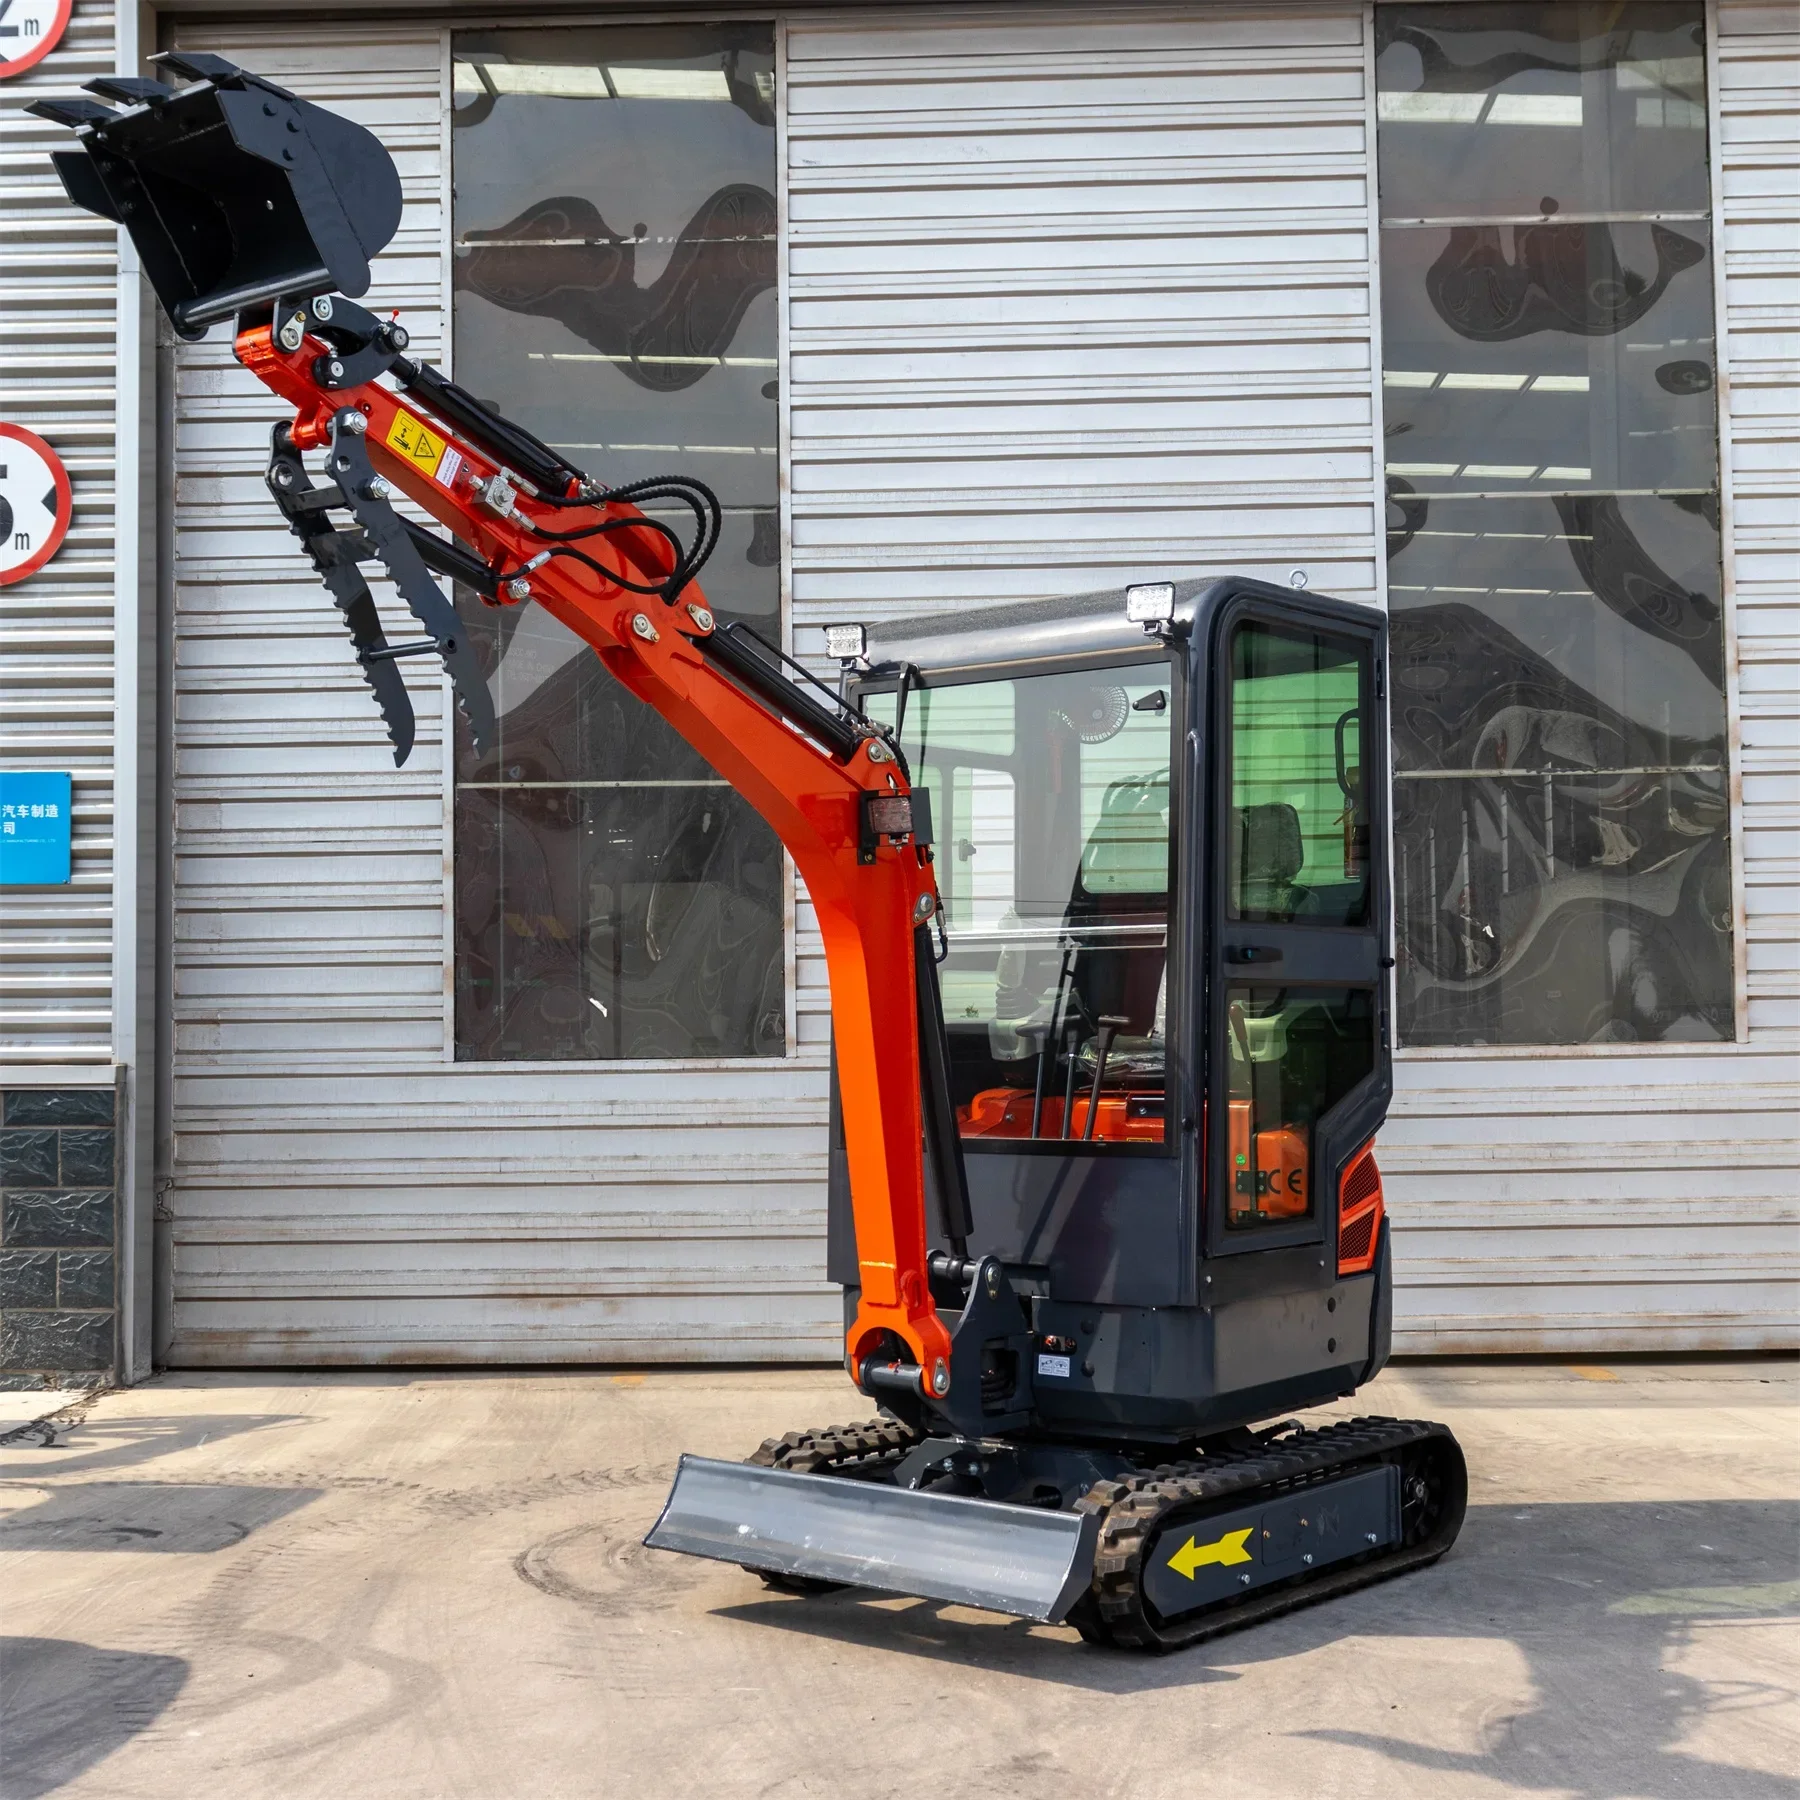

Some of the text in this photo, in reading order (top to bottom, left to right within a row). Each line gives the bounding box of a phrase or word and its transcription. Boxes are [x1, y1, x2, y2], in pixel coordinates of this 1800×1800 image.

[2, 804, 59, 818] 汽车制造
[1267, 1168, 1303, 1195] CE
